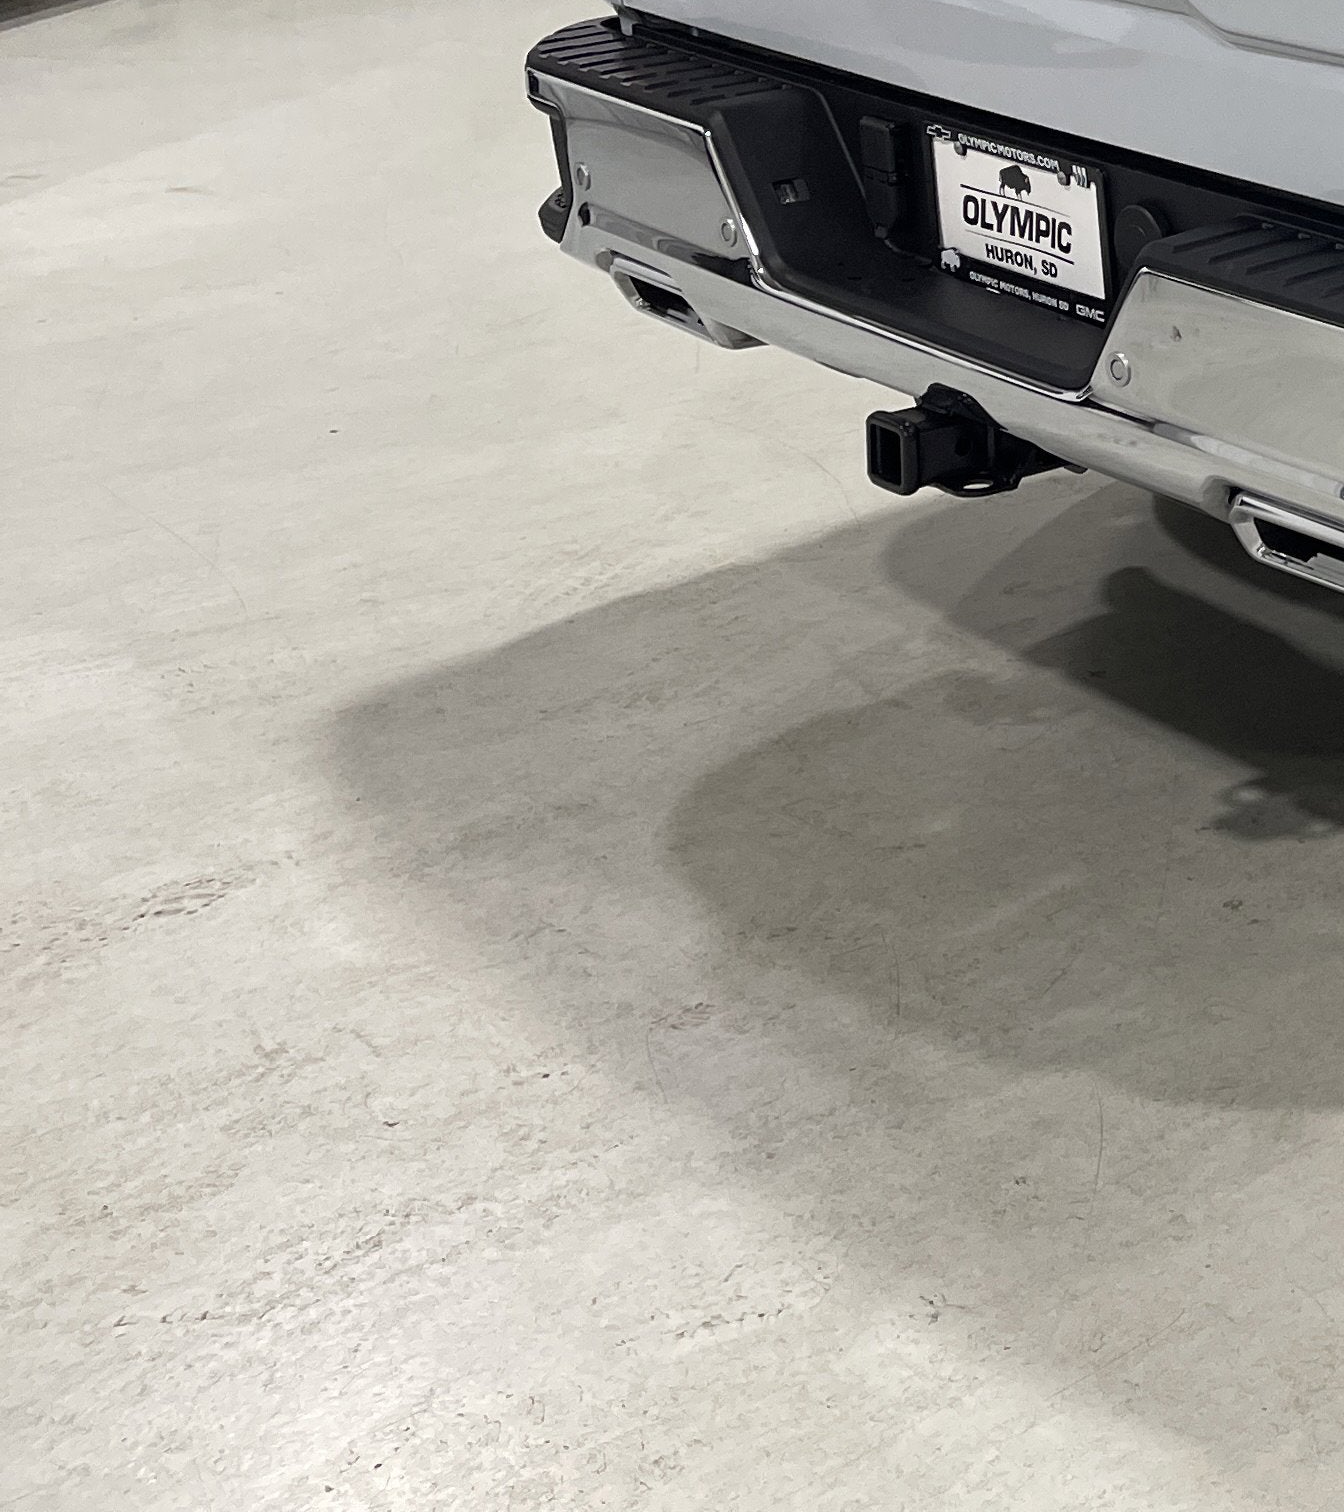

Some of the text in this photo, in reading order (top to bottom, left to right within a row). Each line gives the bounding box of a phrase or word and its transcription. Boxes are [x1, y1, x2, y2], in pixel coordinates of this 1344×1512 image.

[957, 133, 1060, 173] OLYMPICMOTORS.COM
[962, 194, 1073, 254] OLYMPIC
[969, 270, 999, 288] OLYMPIC
[985, 243, 1058, 279] HURON, SD
[1075, 304, 1105, 322] GMC
